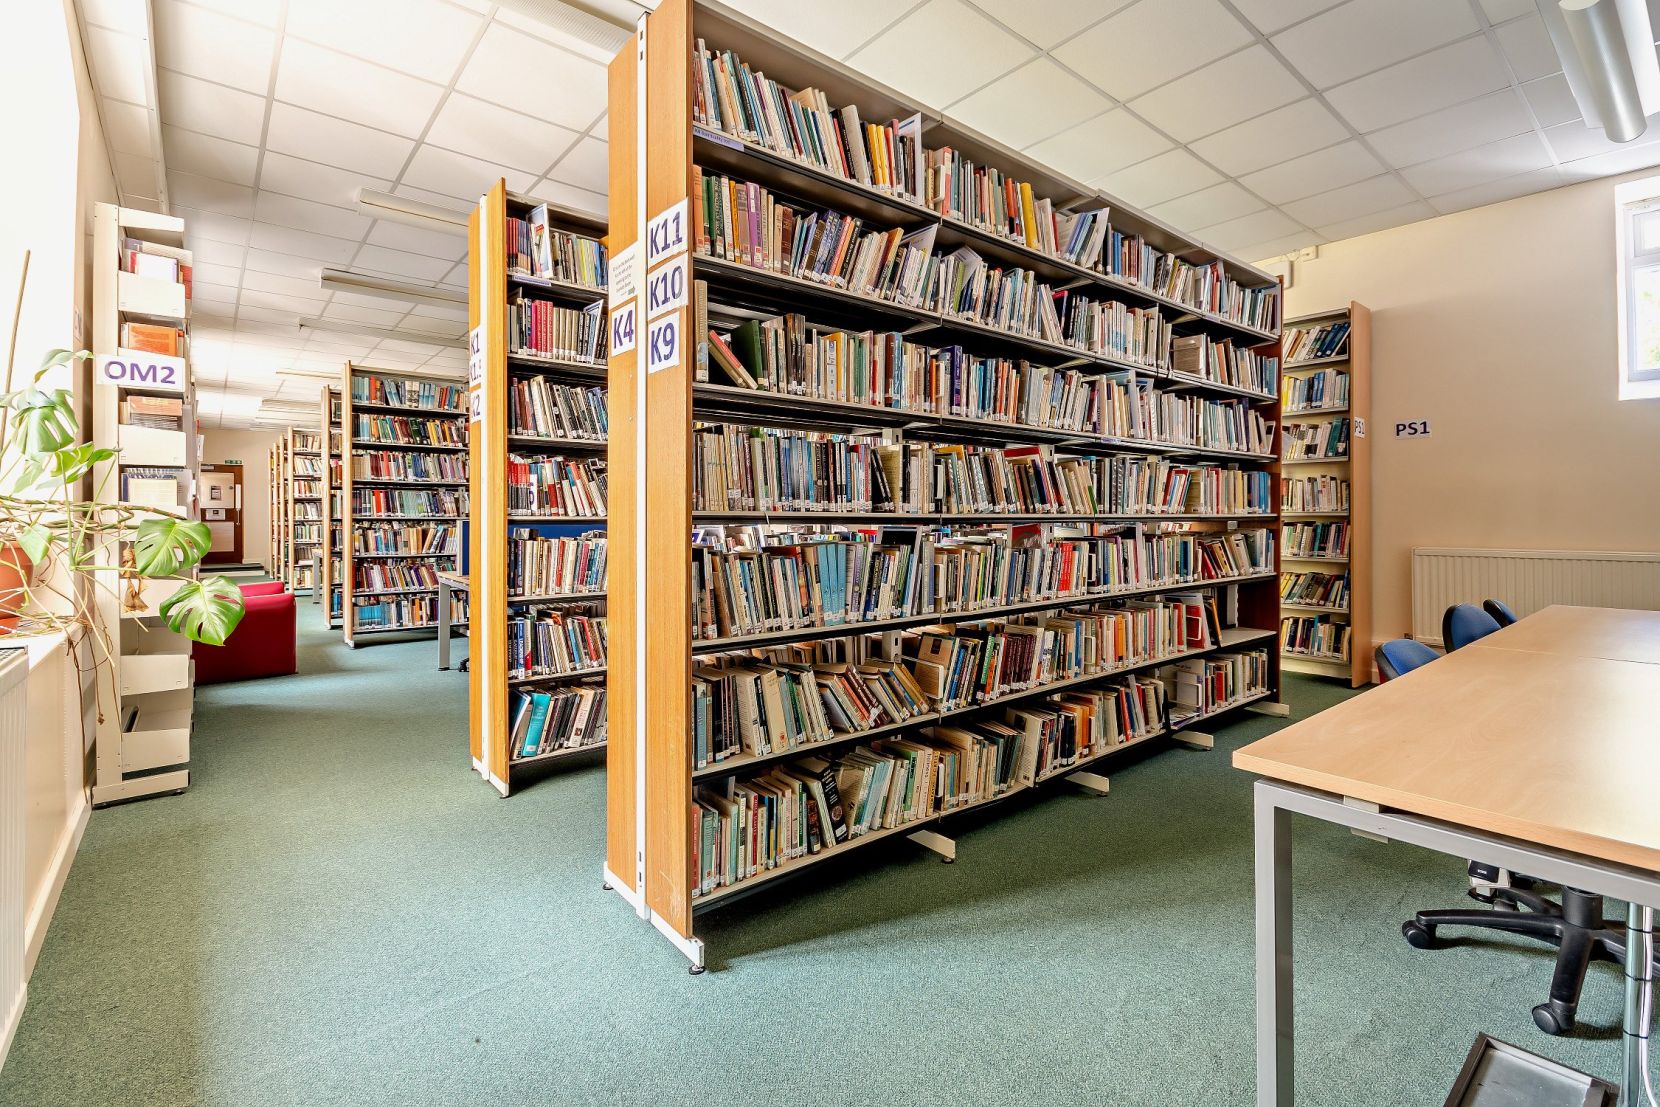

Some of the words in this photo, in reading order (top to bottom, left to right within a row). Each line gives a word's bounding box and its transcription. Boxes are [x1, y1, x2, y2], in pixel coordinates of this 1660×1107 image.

[650, 211, 683, 259] K11
[650, 265, 684, 311] K10
[613, 309, 634, 349] K4
[650, 322, 675, 365] K9
[104, 360, 176, 385] OM2
[1354, 420, 1365, 435] PS1
[1395, 420, 1430, 437] PS1
